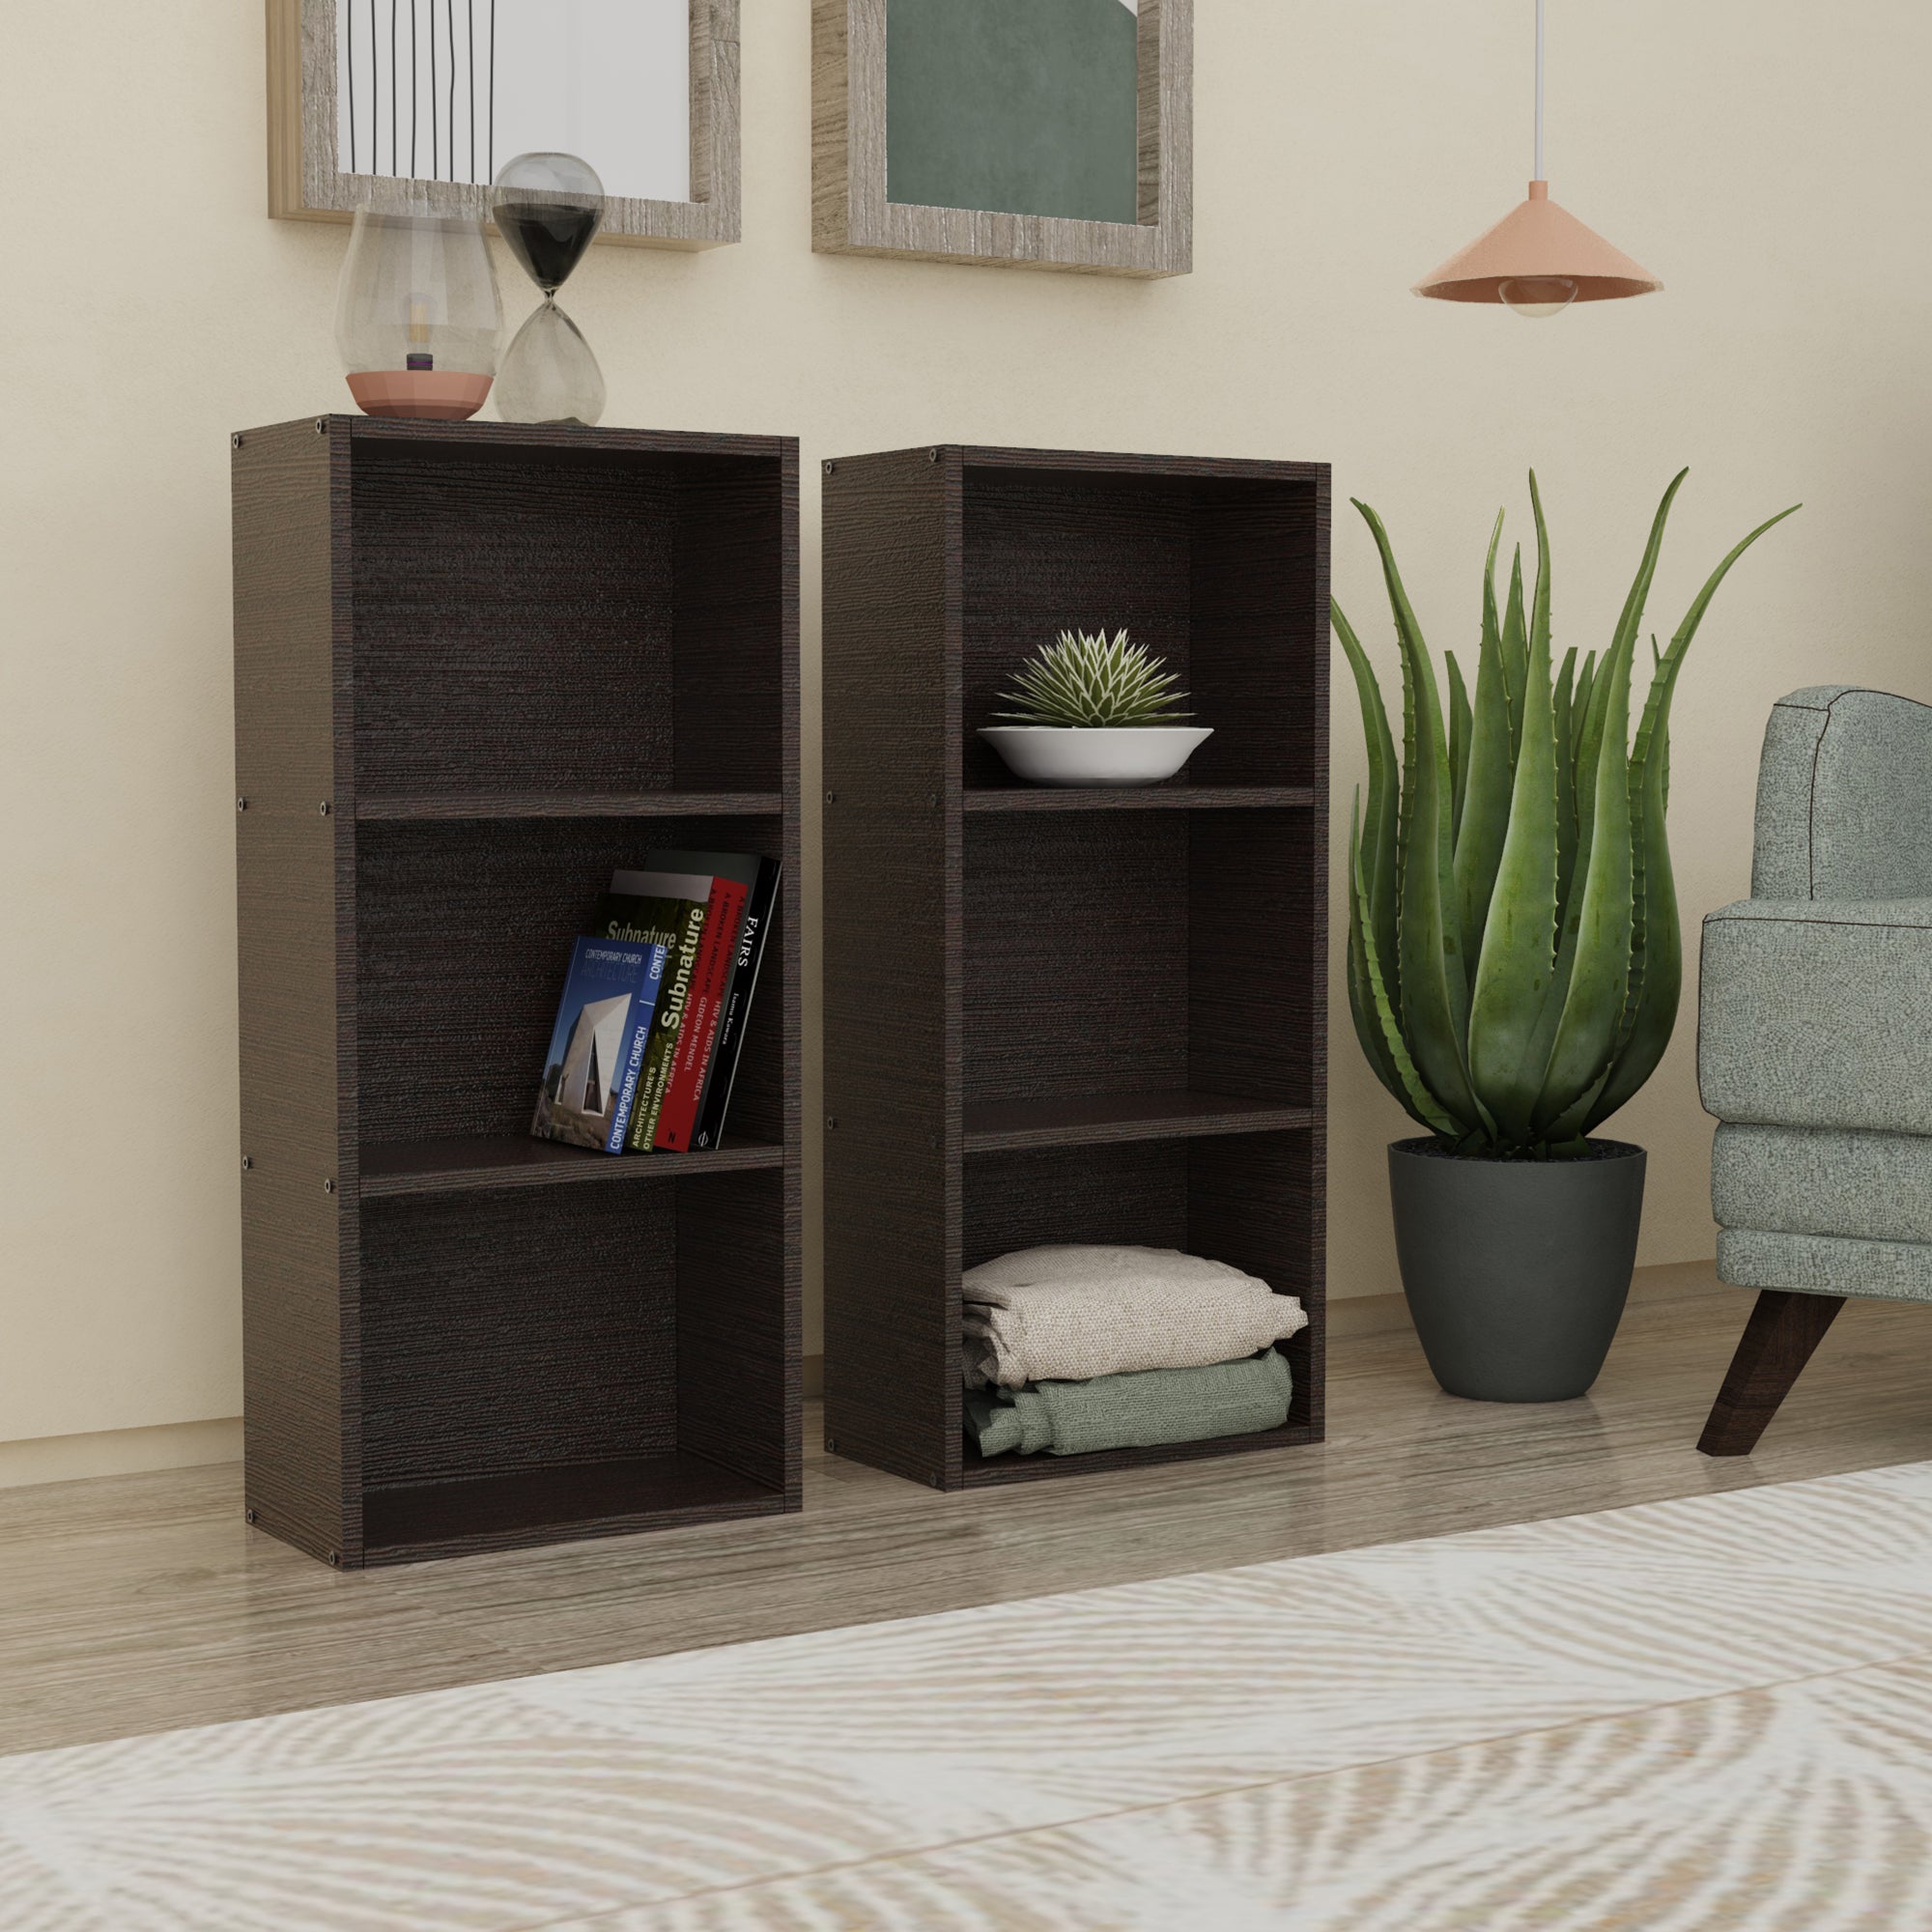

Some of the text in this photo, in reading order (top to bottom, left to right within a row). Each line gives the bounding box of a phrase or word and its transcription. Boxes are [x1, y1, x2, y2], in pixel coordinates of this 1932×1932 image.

[716, 901, 730, 939] BROKEN
[584, 948, 642, 965] CONTEMPORARY CHURCH
[737, 916, 759, 967] FAIRS
[661, 908, 703, 1030] Subnature
[703, 941, 721, 994] LANDSCAPE
[694, 996, 708, 1033] GIDEON
[712, 1000, 722, 1019] HIV
[684, 1035, 698, 1072] MENDEL
[704, 1029, 716, 1052] AIDS
[701, 1054, 709, 1066] IN
[611, 1026, 647, 1150] CONTEMPORARY CHURCH
[643, 1042, 673, 1150] OTHER ENVIRONMENTS
[693, 1067, 707, 1101] AFRICA
[632, 1065, 657, 1148] ARCHITECTURE'S
